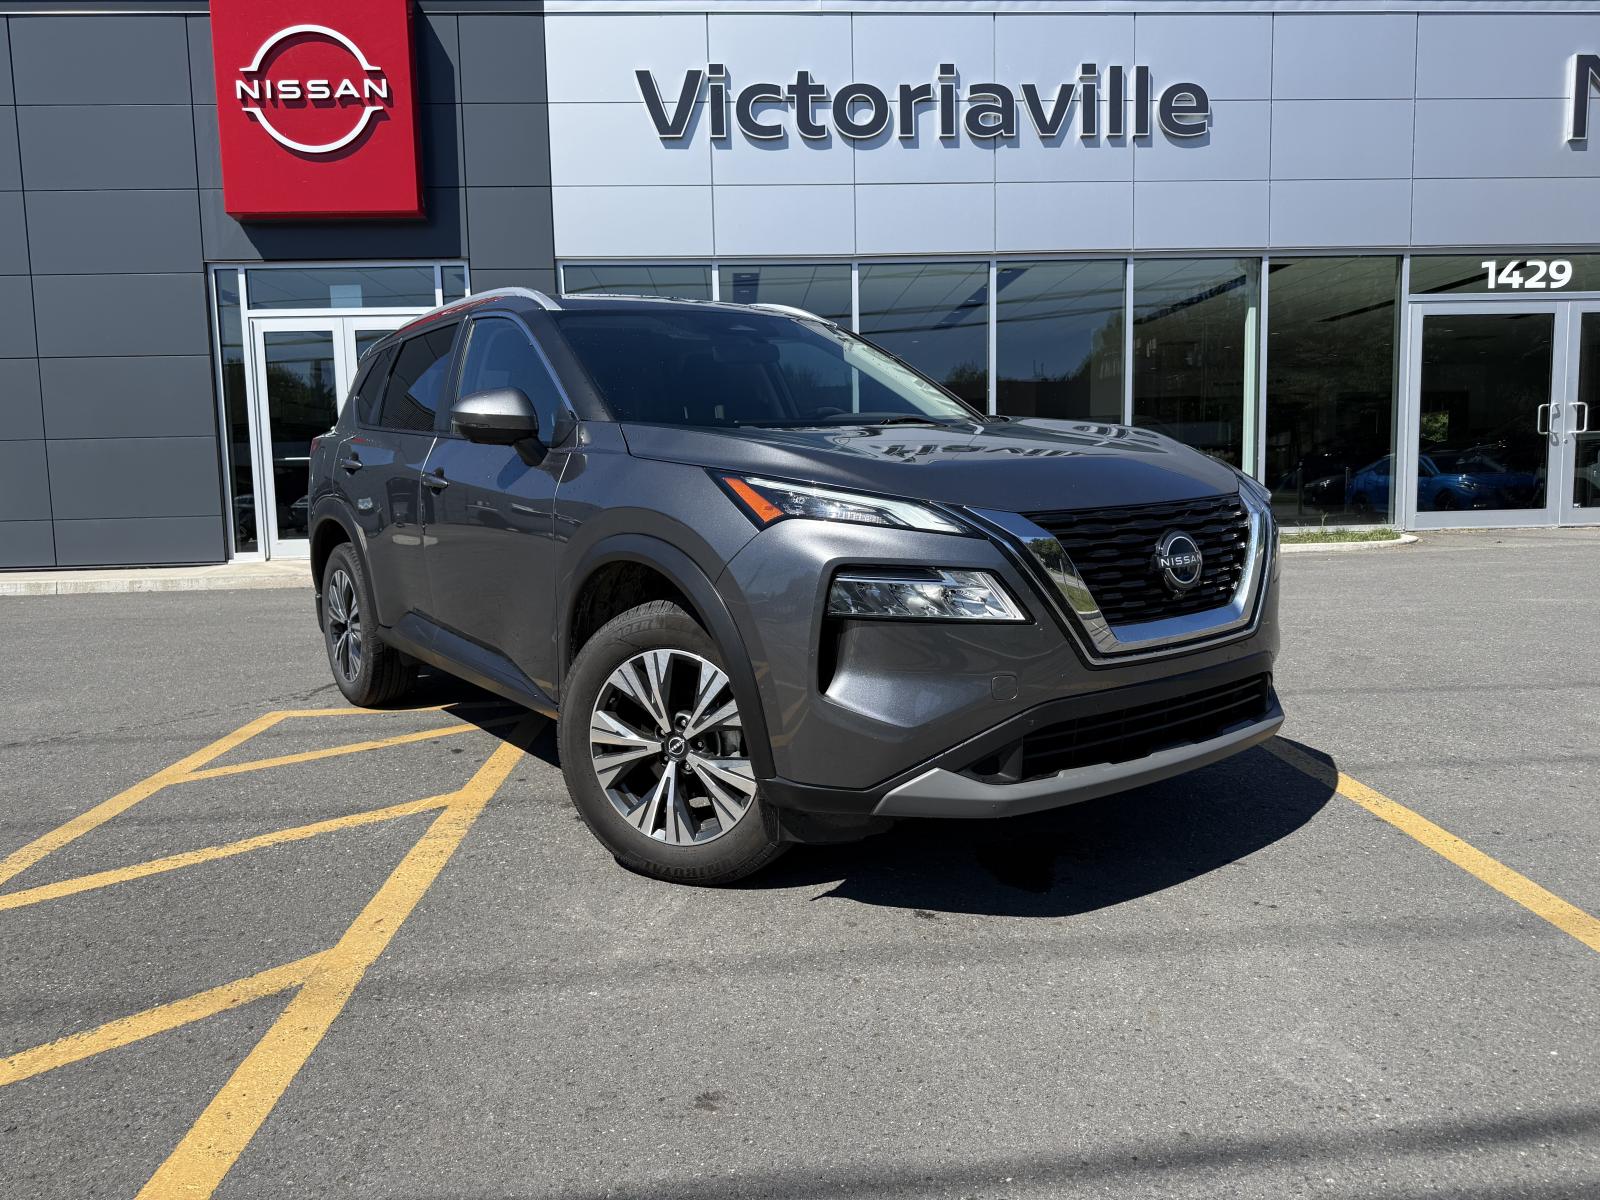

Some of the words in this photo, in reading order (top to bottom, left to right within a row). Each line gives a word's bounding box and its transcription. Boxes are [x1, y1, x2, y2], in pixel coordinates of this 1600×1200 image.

[235, 78, 388, 100] NISSAN
[634, 63, 1210, 139] Victoriaville
[1481, 260, 1573, 289] 1429
[1160, 554, 1201, 567] NISSAN
